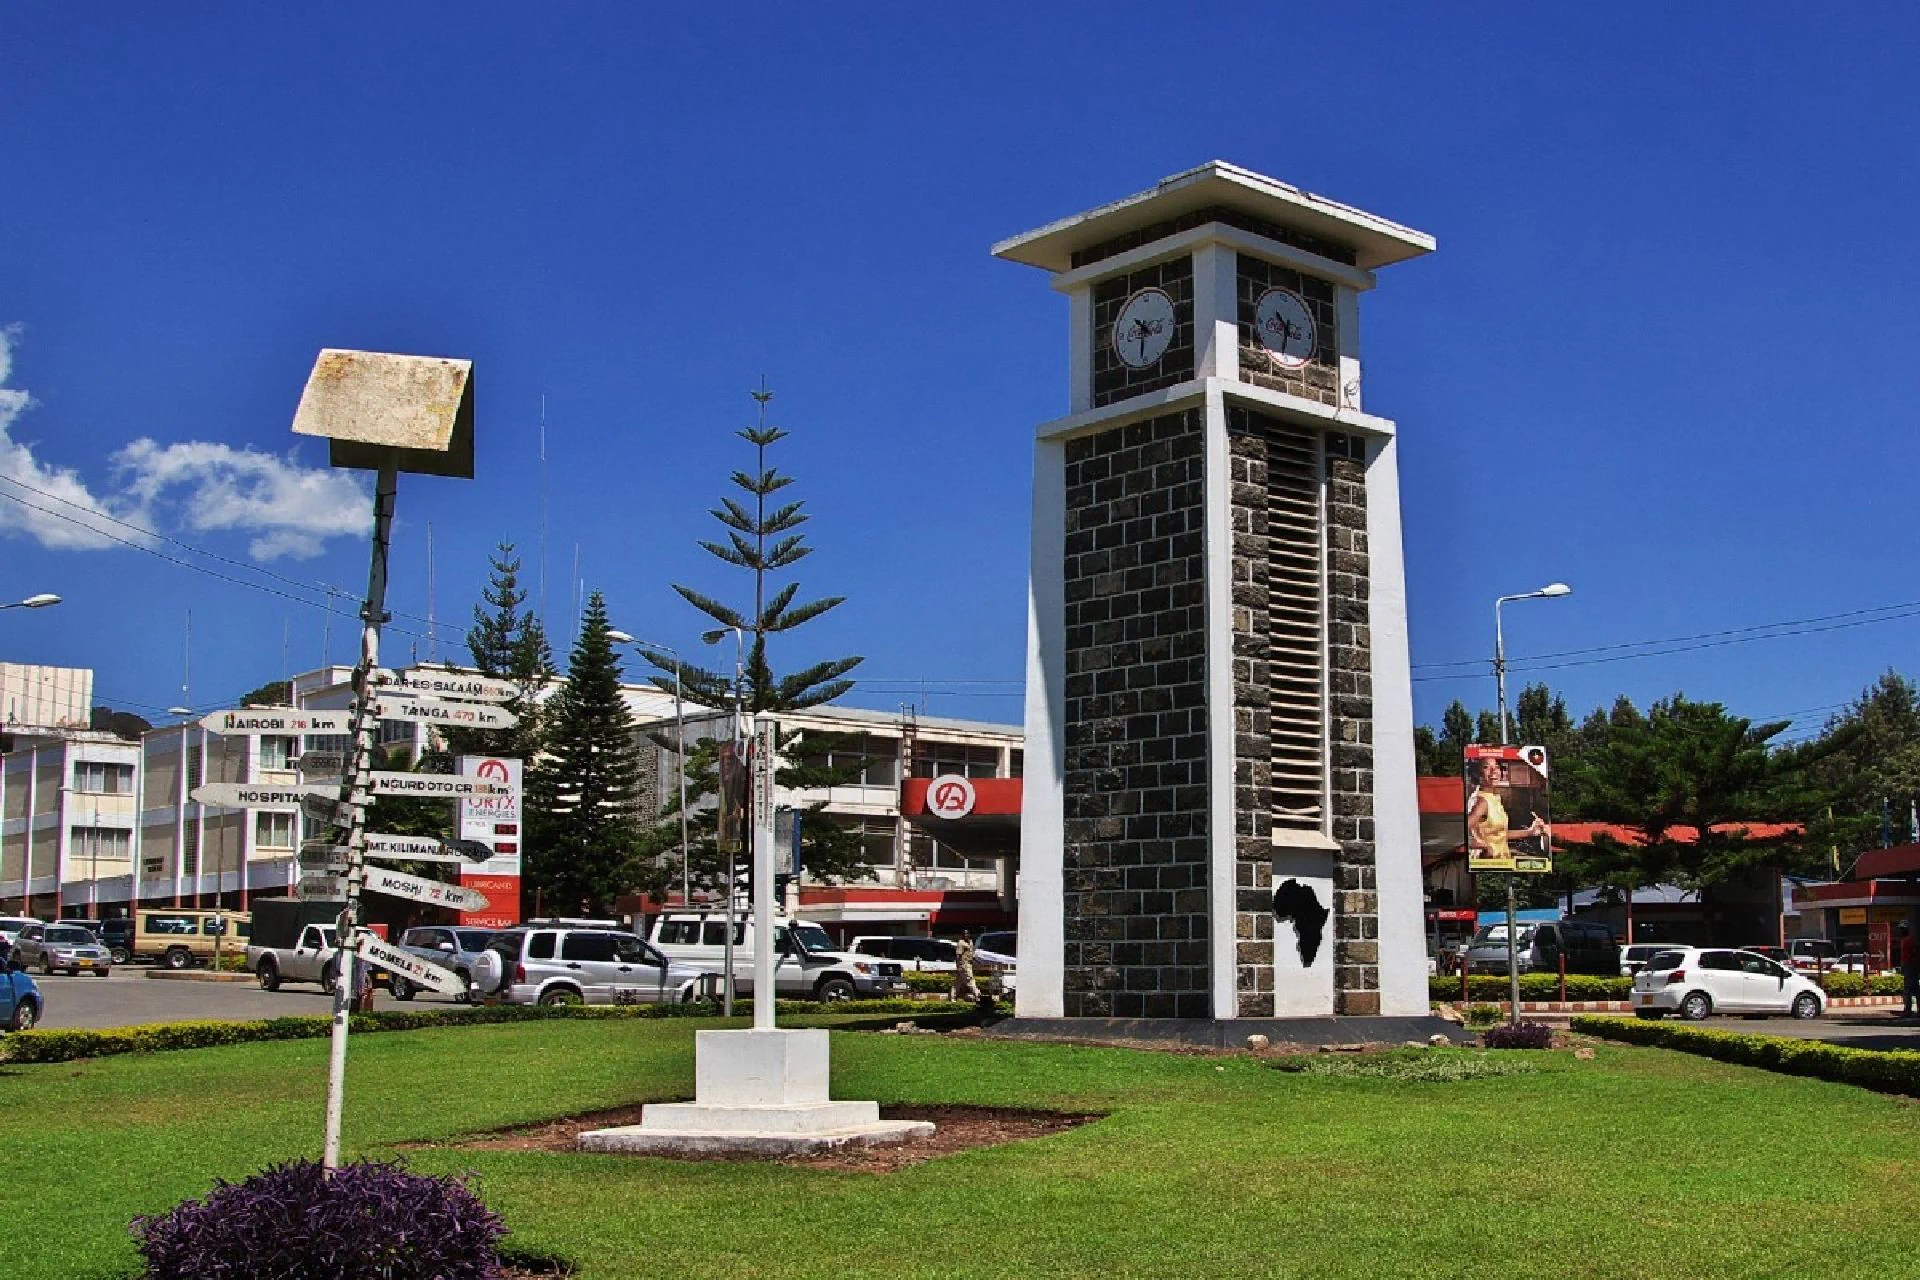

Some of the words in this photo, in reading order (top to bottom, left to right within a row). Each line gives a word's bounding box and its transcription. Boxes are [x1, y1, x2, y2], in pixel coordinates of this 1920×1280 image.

[224, 713, 285, 729] NAIROBI
[311, 717, 336, 729] km
[401, 705, 449, 719] TANGA
[479, 712, 497, 723] km
[238, 790, 304, 803] HOSPITA
[489, 783, 509, 795] km
[381, 877, 422, 895] MOSHI
[444, 889, 464, 904] km
[424, 968, 443, 983] km
